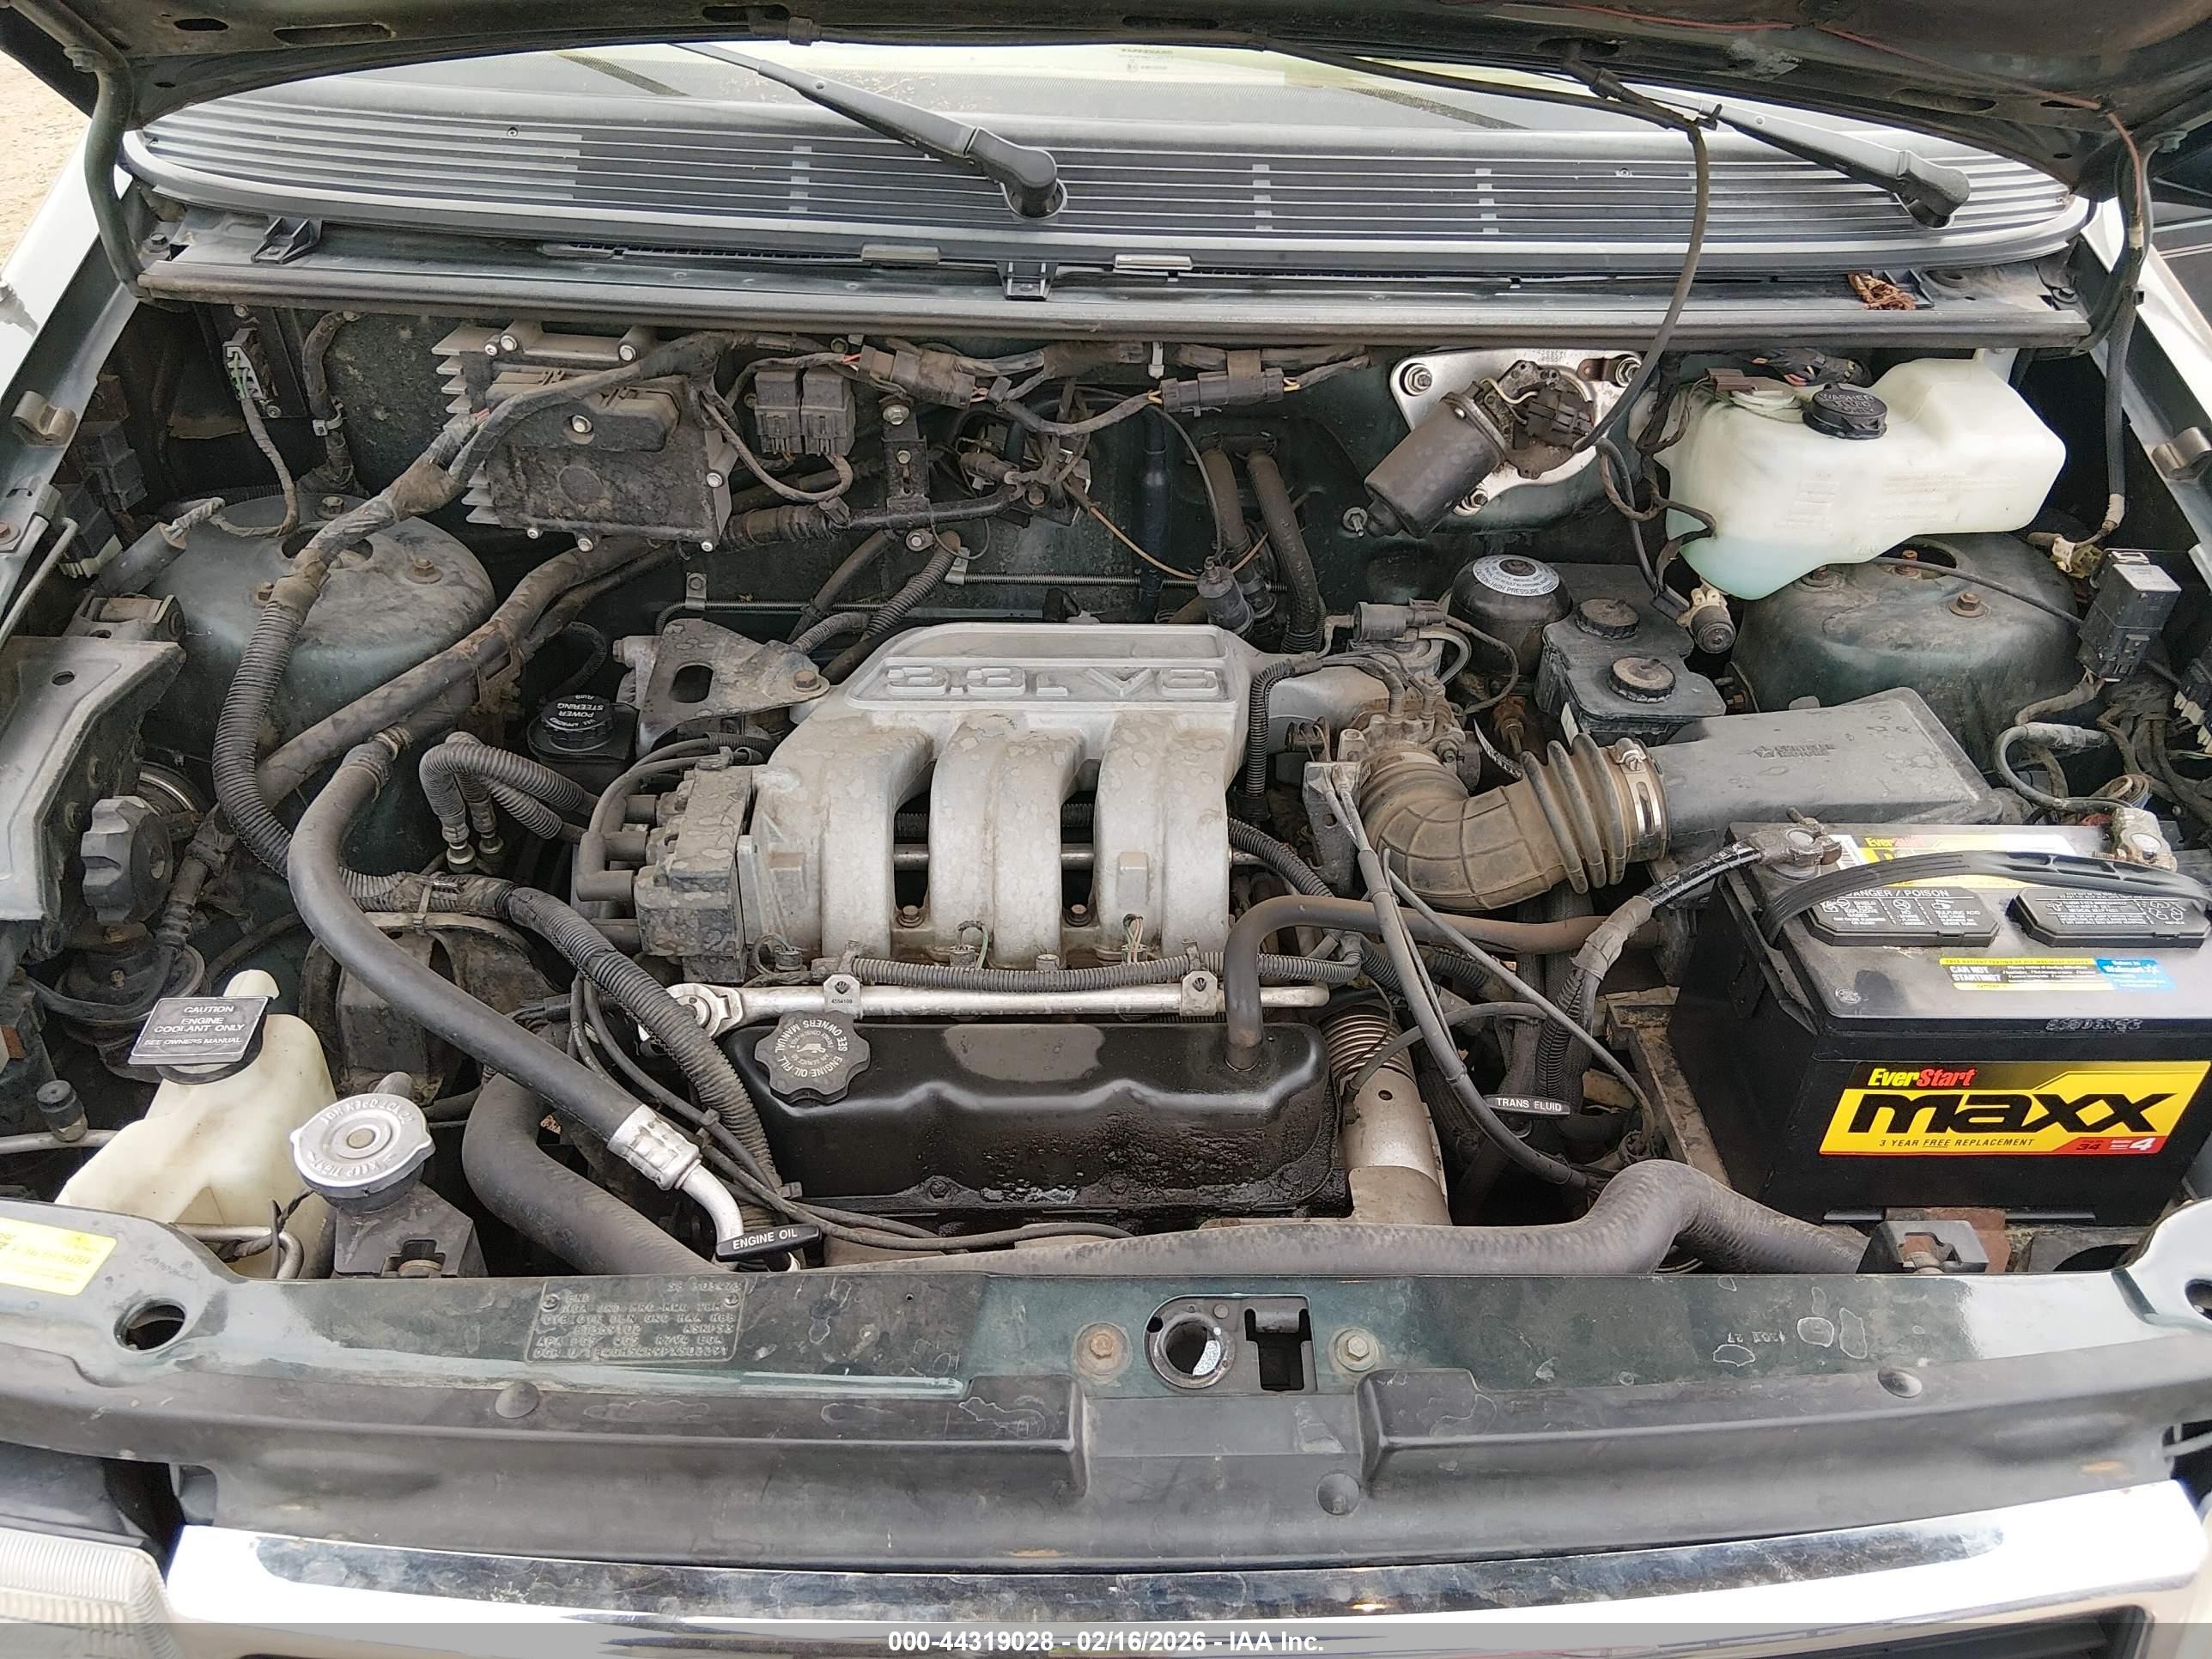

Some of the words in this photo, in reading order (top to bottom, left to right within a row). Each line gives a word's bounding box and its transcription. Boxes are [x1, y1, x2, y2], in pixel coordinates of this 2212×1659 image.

[886, 665, 1068, 697] 3.3L
[1084, 666, 1220, 698] V6
[556, 702, 605, 711] STEERING
[180, 1017, 225, 1025] ENGINE
[216, 1024, 245, 1032] ONLY
[802, 1019, 843, 1036] OWNERS
[775, 1023, 801, 1054] MANUAL
[836, 1036, 848, 1052] SEE
[777, 1054, 793, 1073] FILL
[810, 1055, 843, 1078] ENGINE
[792, 1067, 809, 1078] OIL
[1867, 1067, 1978, 1087] EverStart
[1496, 1097, 1530, 1109] TRANS
[1534, 1100, 1563, 1112] FLUID
[1847, 1092, 2179, 1134] maxx
[1923, 1139, 1952, 1147] FREE
[1954, 1138, 2036, 1147] REPLACEMENT
[2129, 1137, 2157, 1152] 4
[732, 1231, 775, 1250] ENGINE
[778, 1228, 799, 1240] OIL
